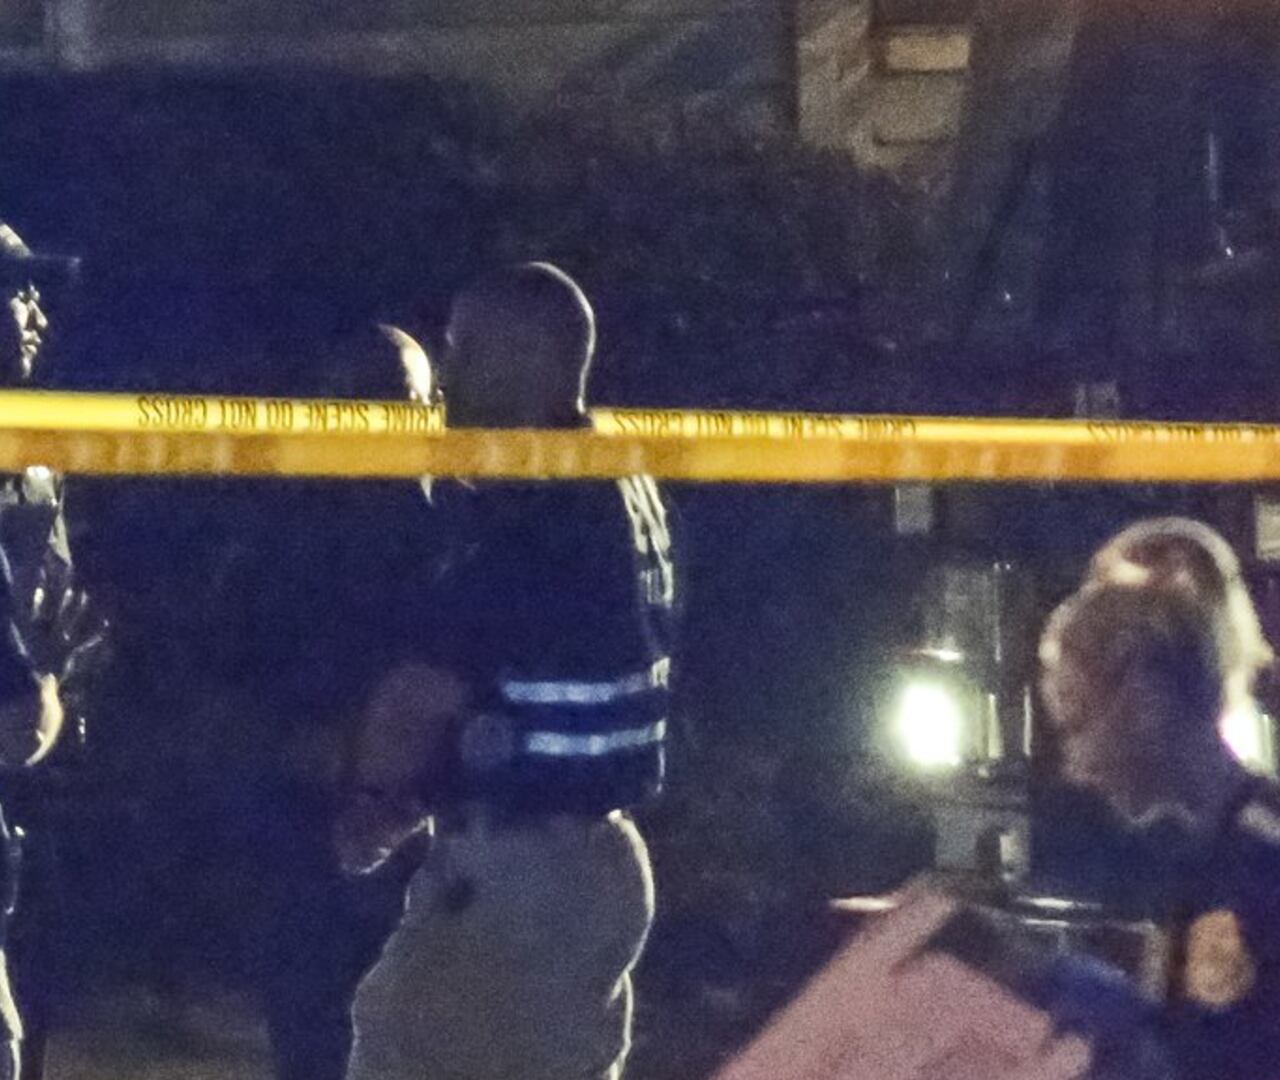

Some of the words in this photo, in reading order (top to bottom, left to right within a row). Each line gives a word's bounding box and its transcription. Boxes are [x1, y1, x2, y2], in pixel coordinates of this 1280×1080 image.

[137, 396, 207, 428] CROSS
[219, 399, 257, 430] NOT
[266, 400, 293, 430] DO
[304, 402, 369, 433] SCENE
